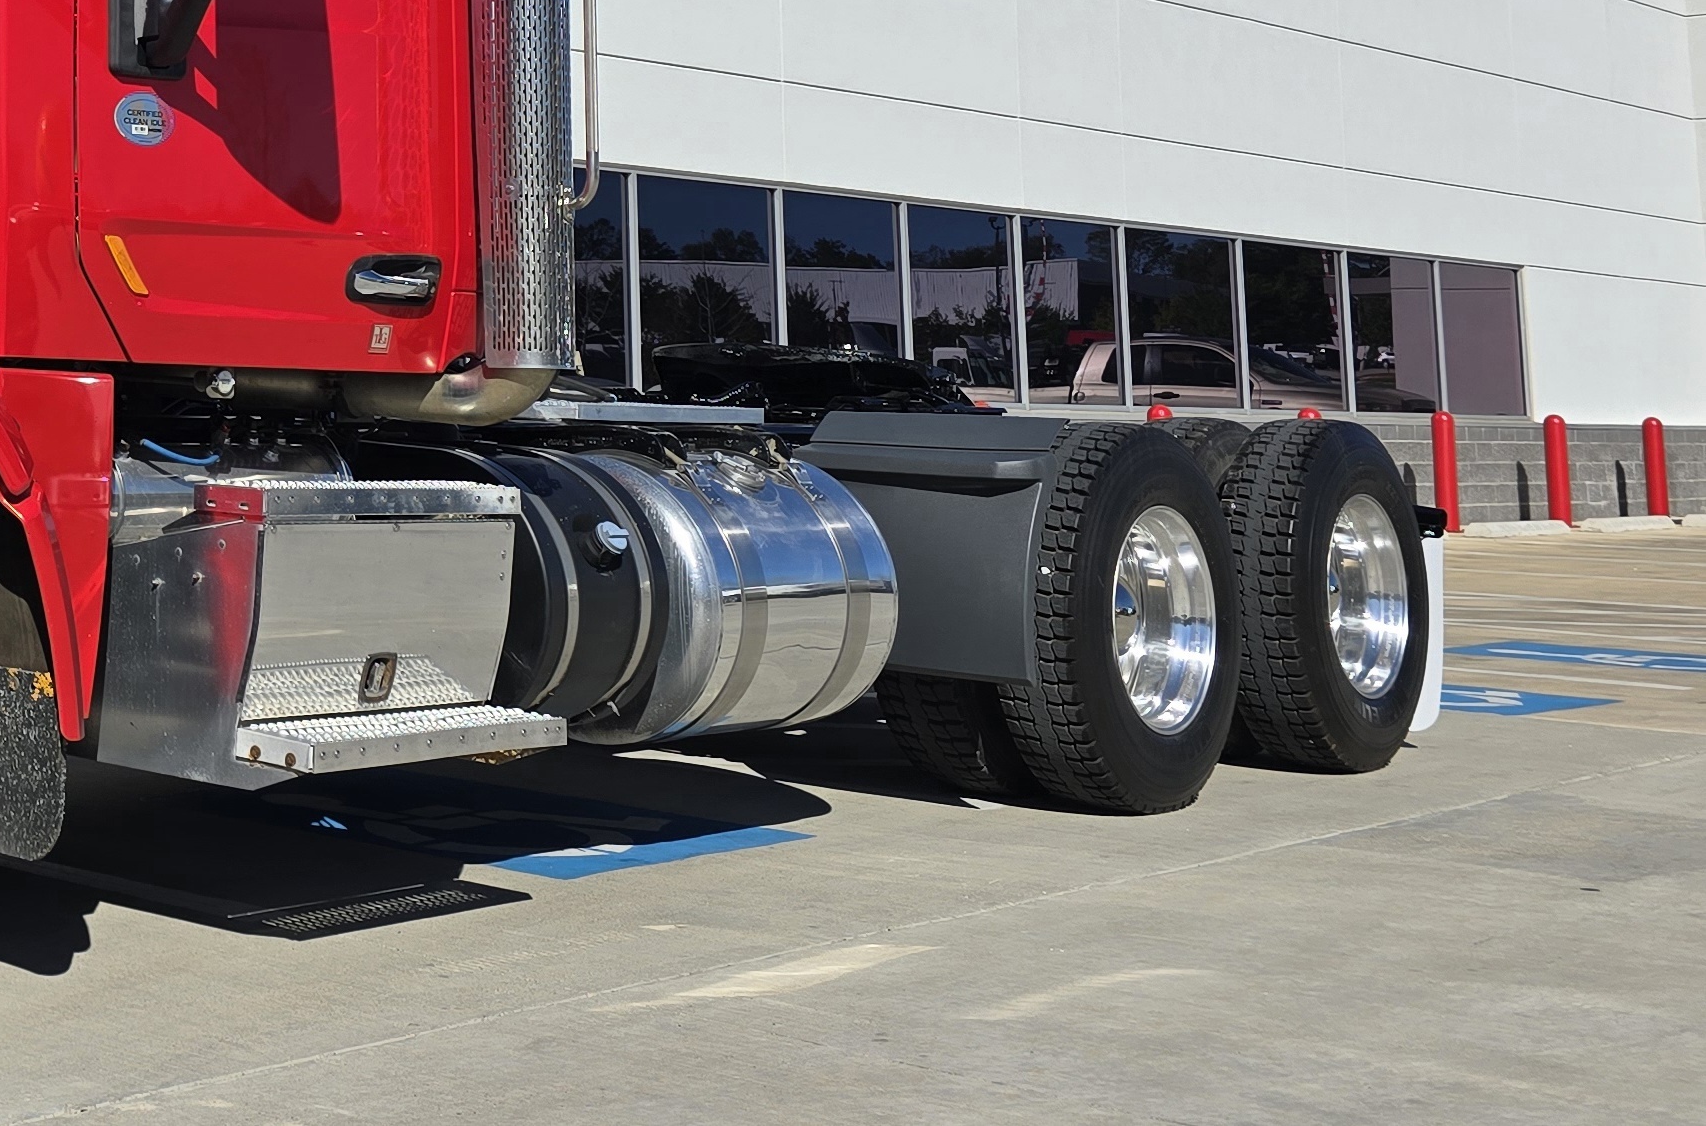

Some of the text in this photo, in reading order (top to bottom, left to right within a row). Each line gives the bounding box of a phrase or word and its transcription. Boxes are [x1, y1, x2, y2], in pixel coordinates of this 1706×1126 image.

[126, 108, 163, 117] CERTIFIED
[123, 117, 167, 127] CLEAN IDLE
